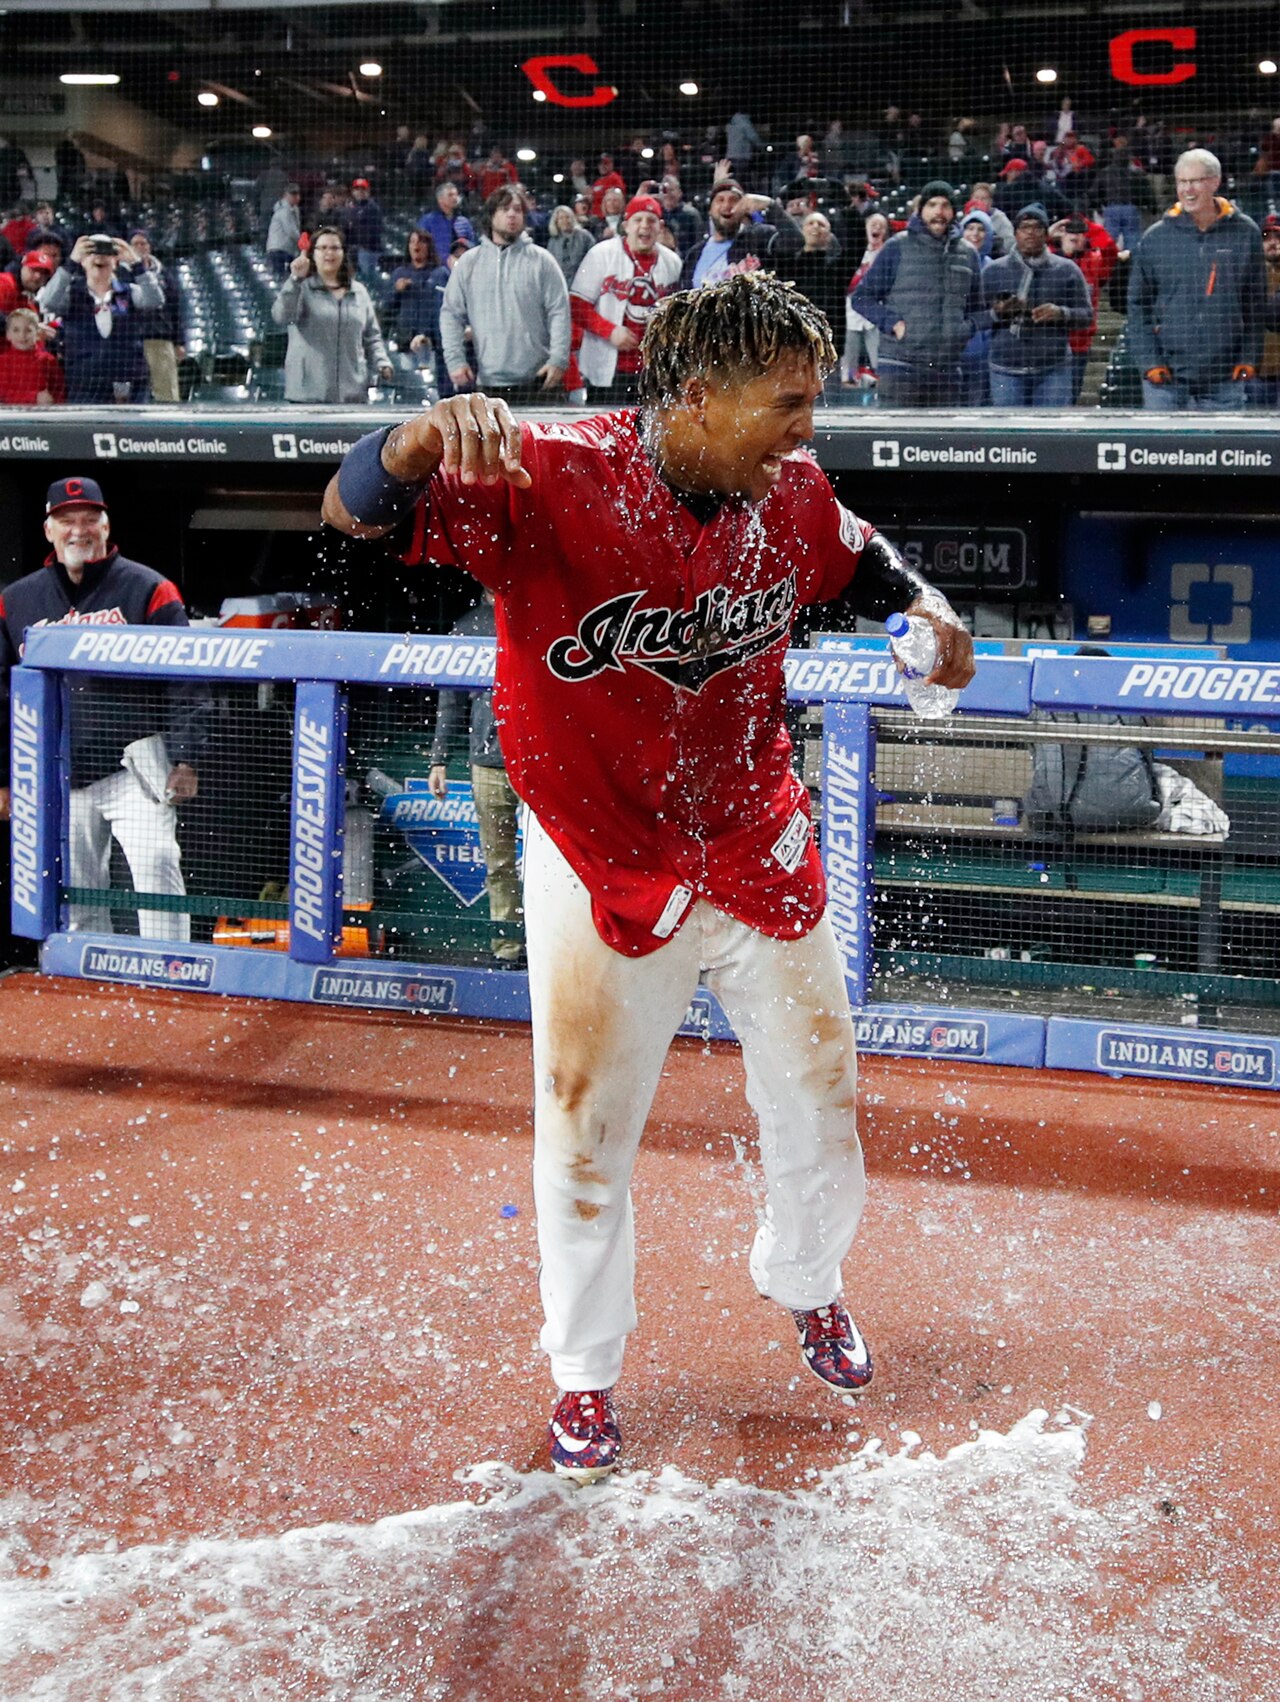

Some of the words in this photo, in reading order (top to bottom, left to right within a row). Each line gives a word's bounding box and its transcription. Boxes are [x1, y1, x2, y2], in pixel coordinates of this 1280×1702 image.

[1109, 27, 1197, 86] C
[522, 54, 617, 107] C
[12, 437, 50, 453] Clinic
[118, 438, 186, 454] Cleveland
[187, 438, 227, 455] Clinic
[903, 446, 986, 464] Cleveland
[988, 446, 1038, 464] Clinic
[1129, 448, 1218, 466] Cleveland
[1220, 449, 1273, 468] Clinic
[65, 479, 83, 496] C
[69, 632, 268, 669] PROGRESSIVE
[13, 698, 39, 915] PROGRESSIVE
[294, 718, 328, 941] PROGRESSIVE
[89, 952, 209, 983] INDIANS.COM
[320, 976, 448, 1005] INDIANS.COM
[1108, 1041, 1266, 1076] INDIANS.COM
